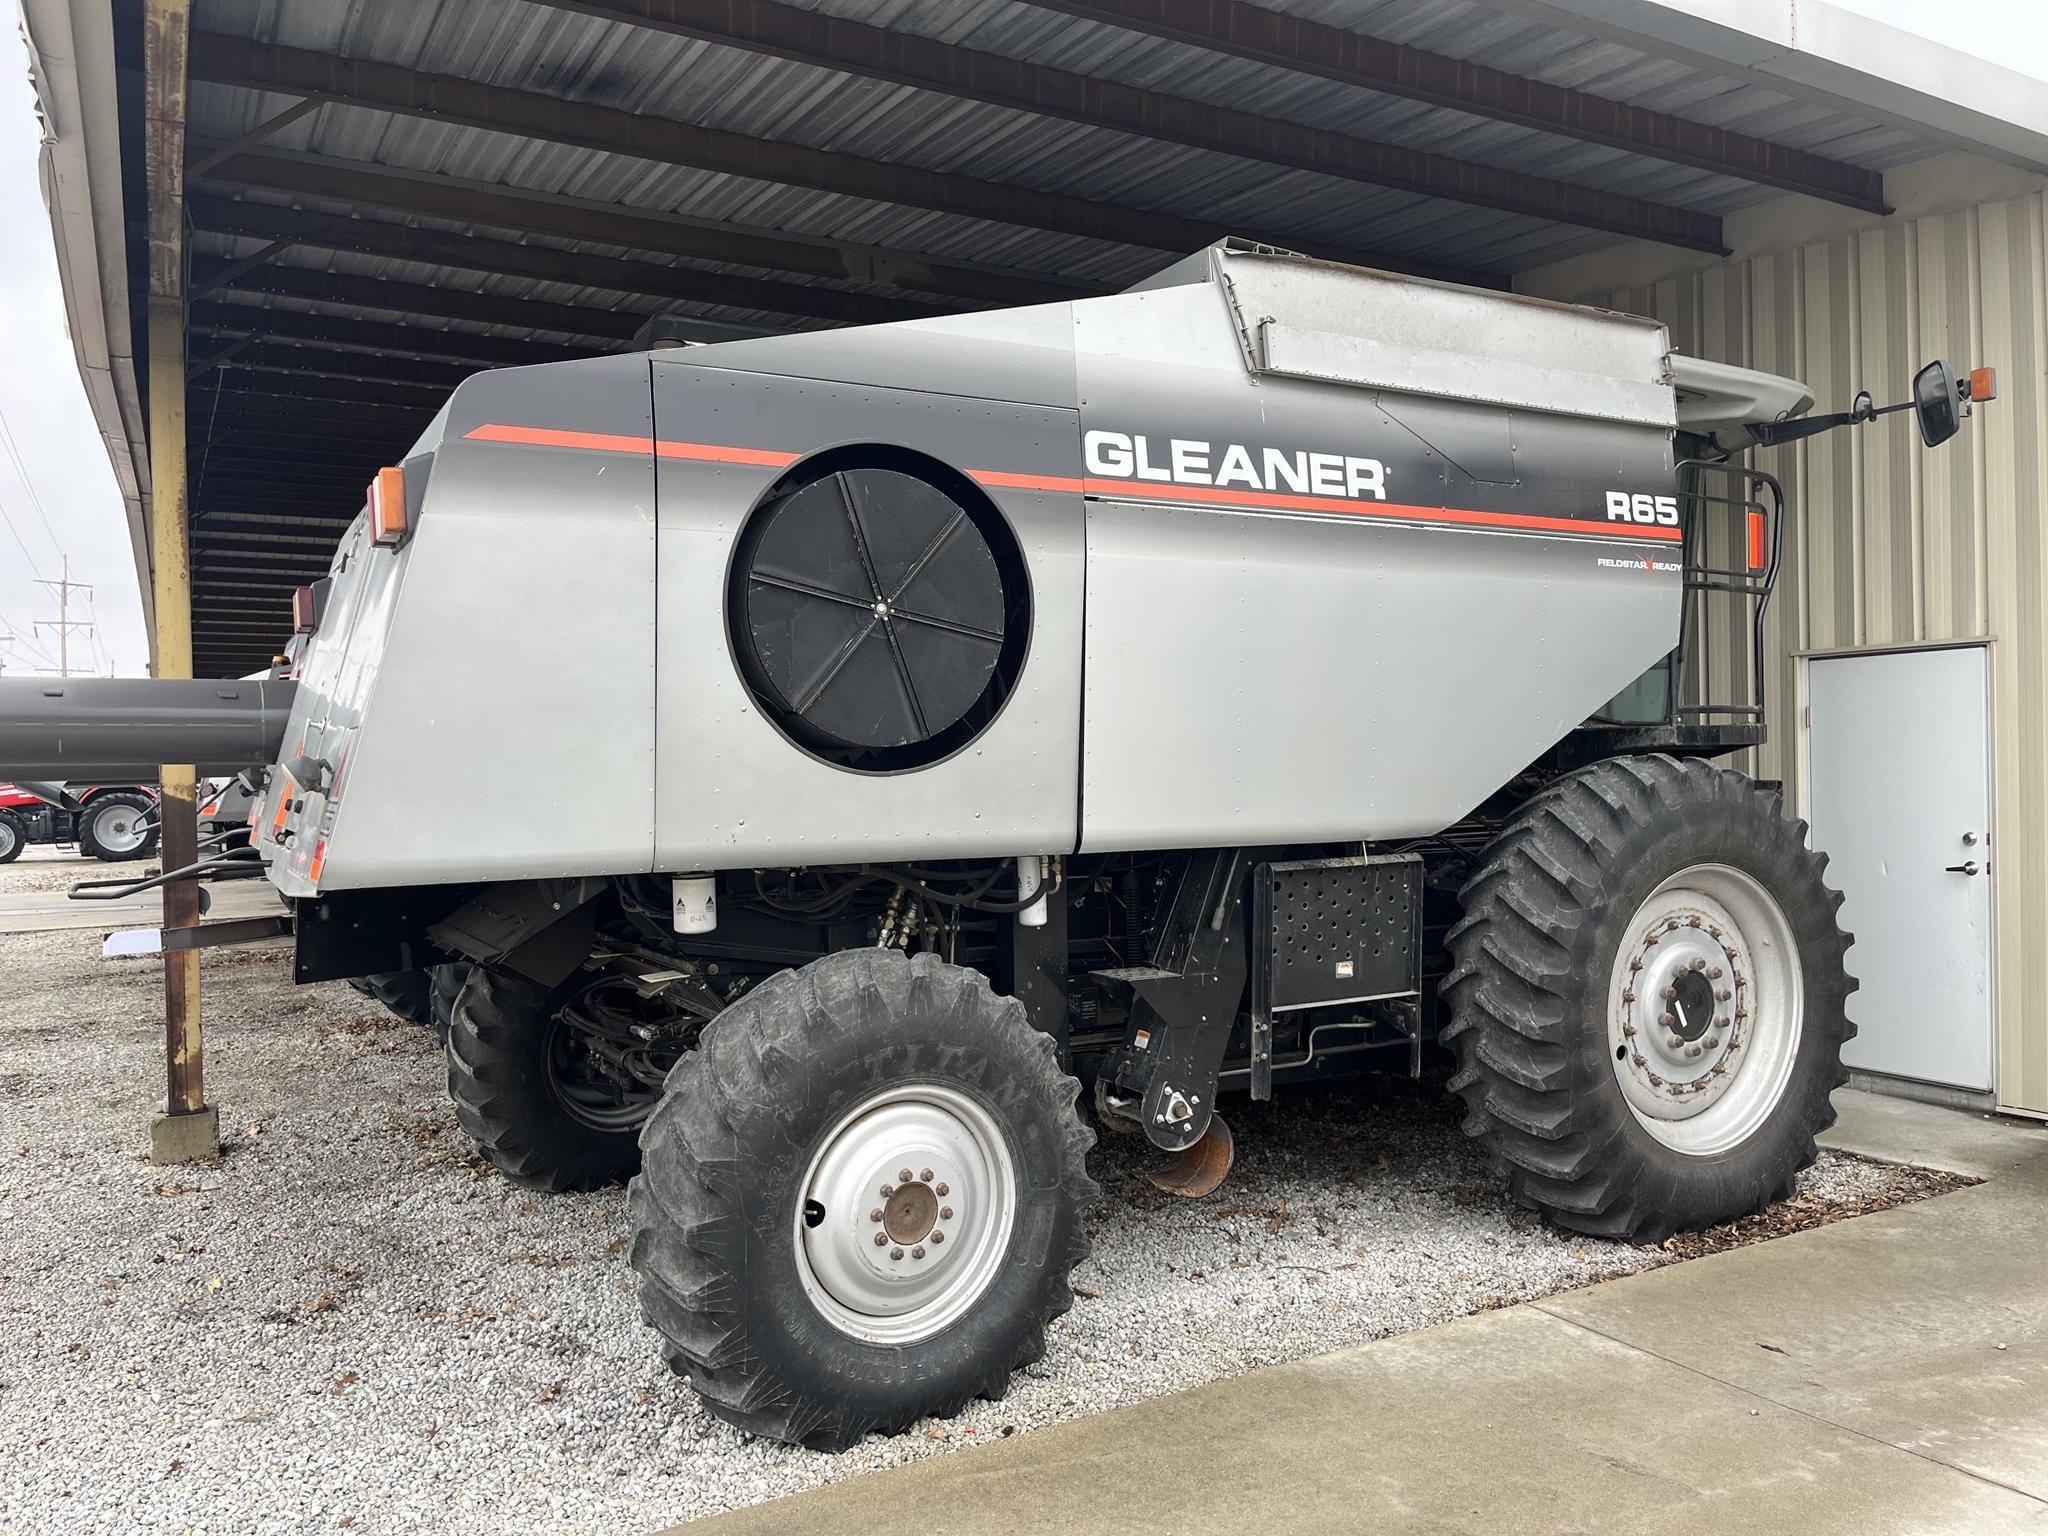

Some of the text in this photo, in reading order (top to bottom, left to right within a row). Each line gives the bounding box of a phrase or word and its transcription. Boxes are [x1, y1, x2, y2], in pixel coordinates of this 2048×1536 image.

[1084, 430, 1386, 500] GLEANER
[1605, 490, 1679, 526] R65
[1597, 558, 1682, 571] FIELDSTAR READY
